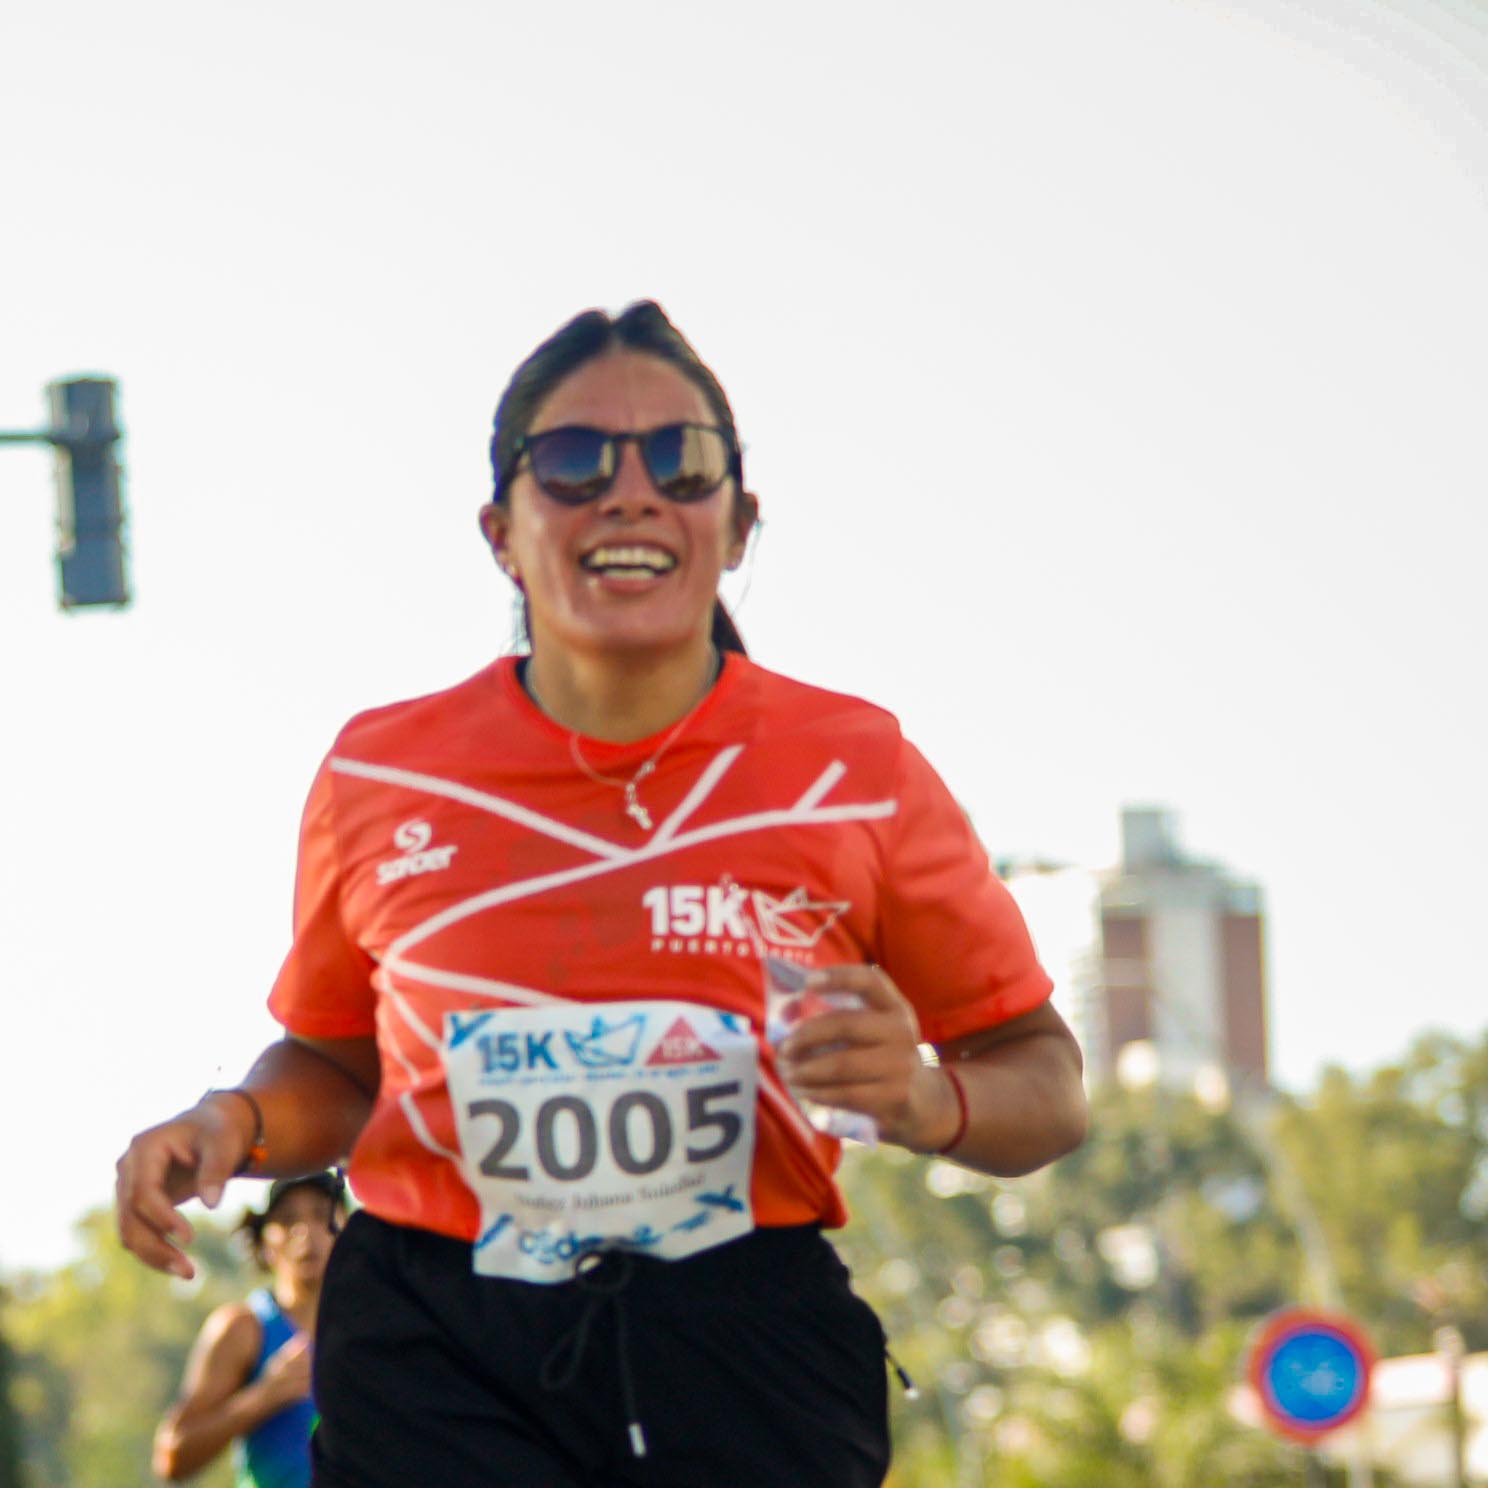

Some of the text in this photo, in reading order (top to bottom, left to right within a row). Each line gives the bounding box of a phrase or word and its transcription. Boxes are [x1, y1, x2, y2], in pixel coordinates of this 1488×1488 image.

[642, 884, 749, 939] 15K
[476, 1029, 560, 1074] 15K
[467, 1080, 744, 1183] 2005
